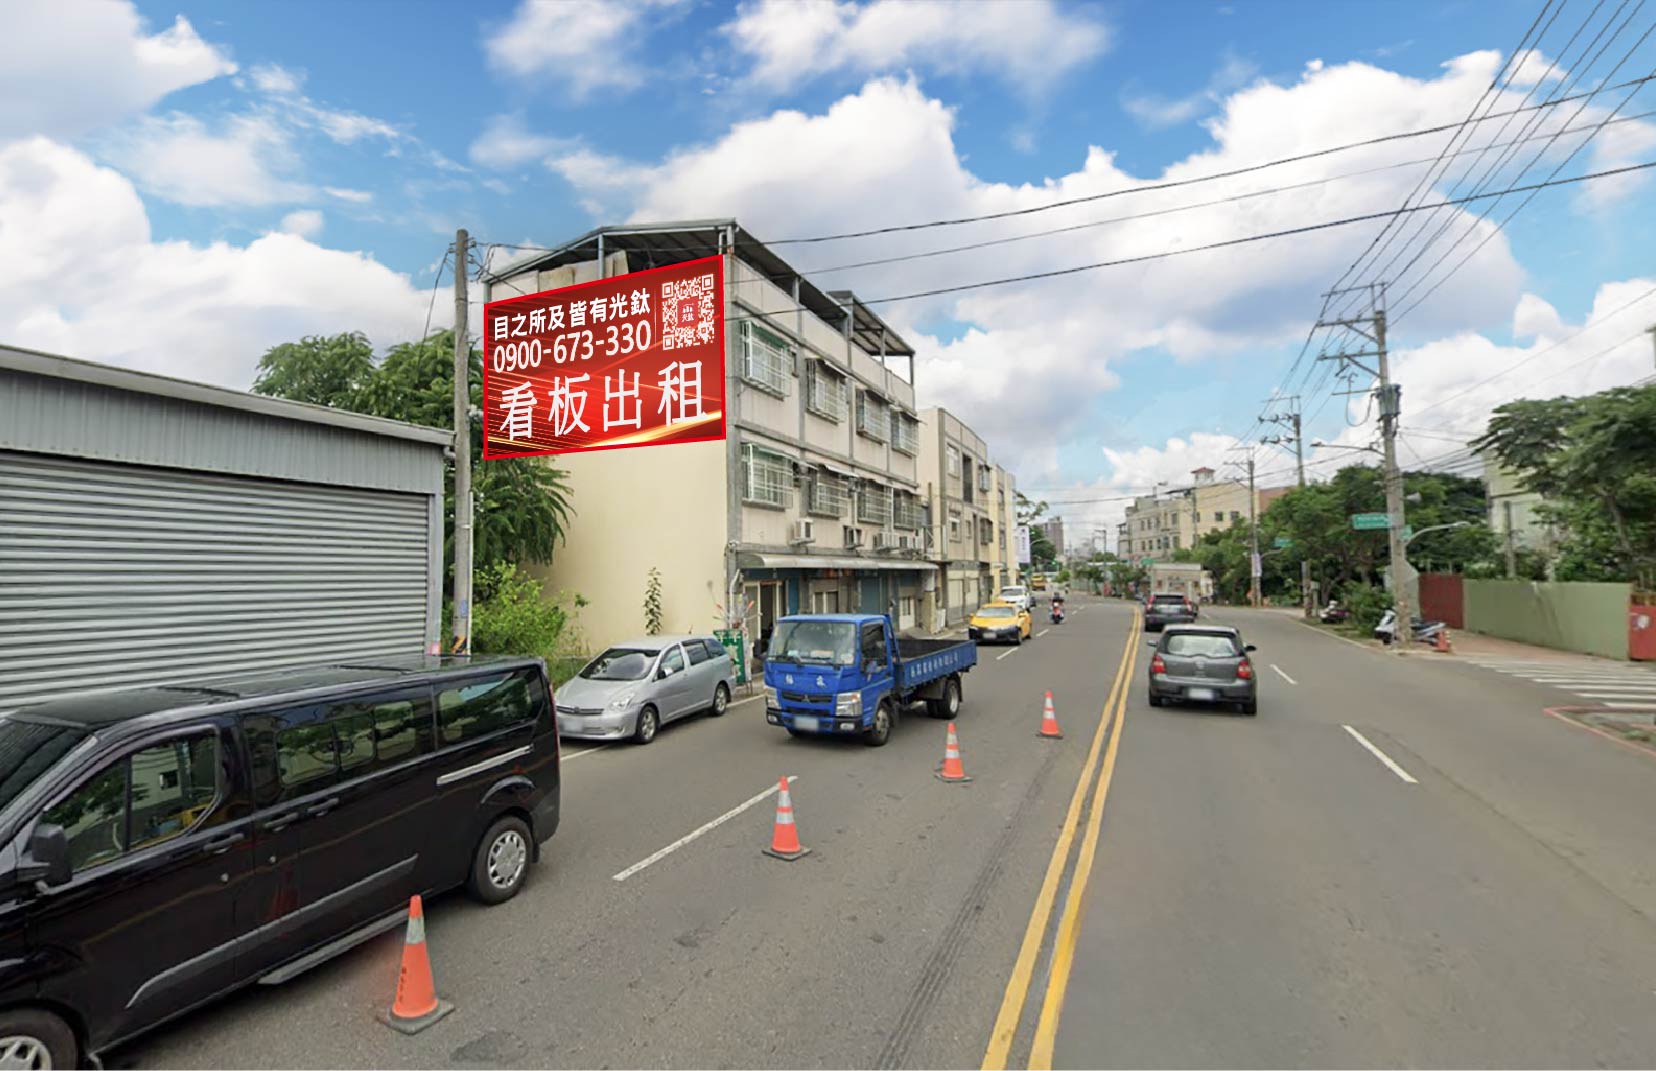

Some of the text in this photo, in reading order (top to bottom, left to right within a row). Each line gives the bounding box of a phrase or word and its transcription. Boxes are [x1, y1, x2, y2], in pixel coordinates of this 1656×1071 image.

[494, 288, 651, 341] 目之所及皆有光鈦
[493, 319, 652, 373] 0900-673-330
[500, 359, 708, 441] 看板出租
